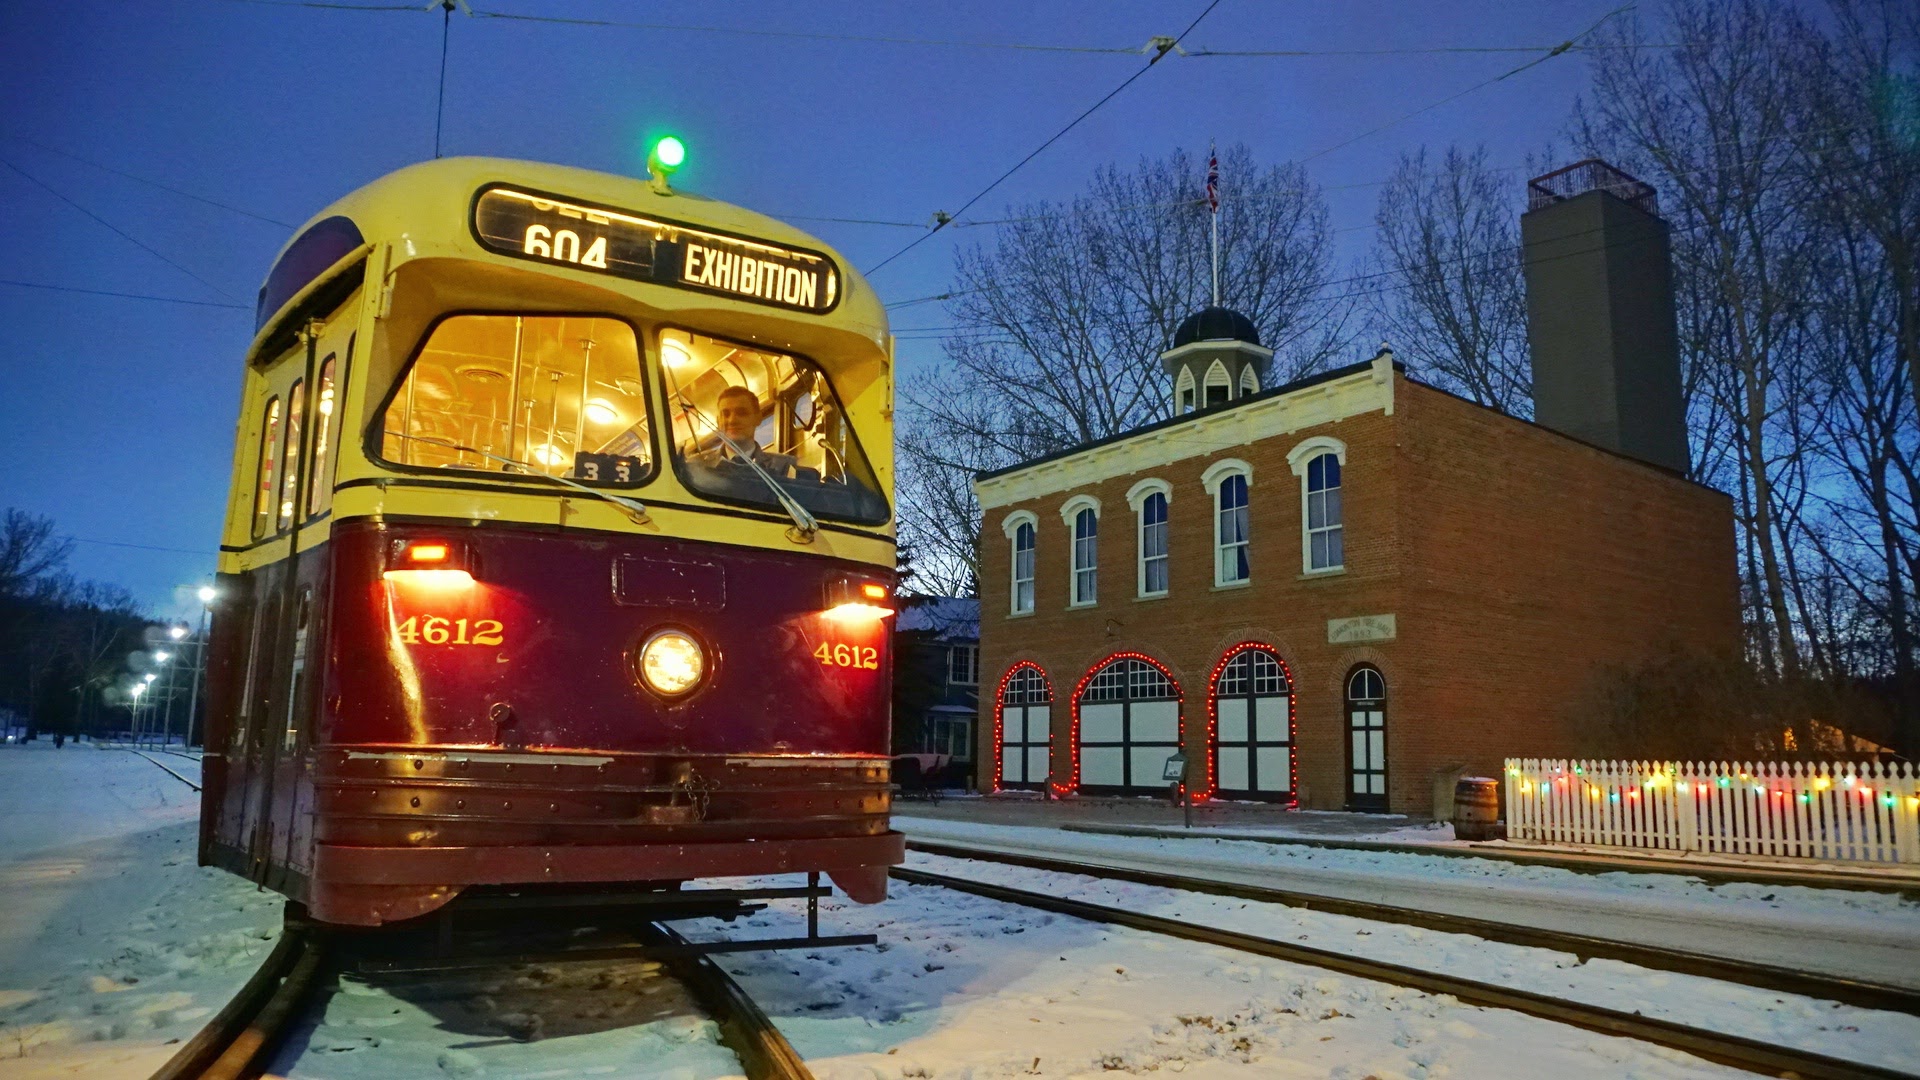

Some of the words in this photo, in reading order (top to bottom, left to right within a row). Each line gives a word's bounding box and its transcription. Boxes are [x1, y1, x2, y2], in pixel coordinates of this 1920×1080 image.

[524, 224, 607, 269] 604
[684, 243, 817, 308] EXHIBITION
[583, 462, 599, 480] 3
[397, 616, 504, 646] 4612
[813, 641, 878, 670] 4612
